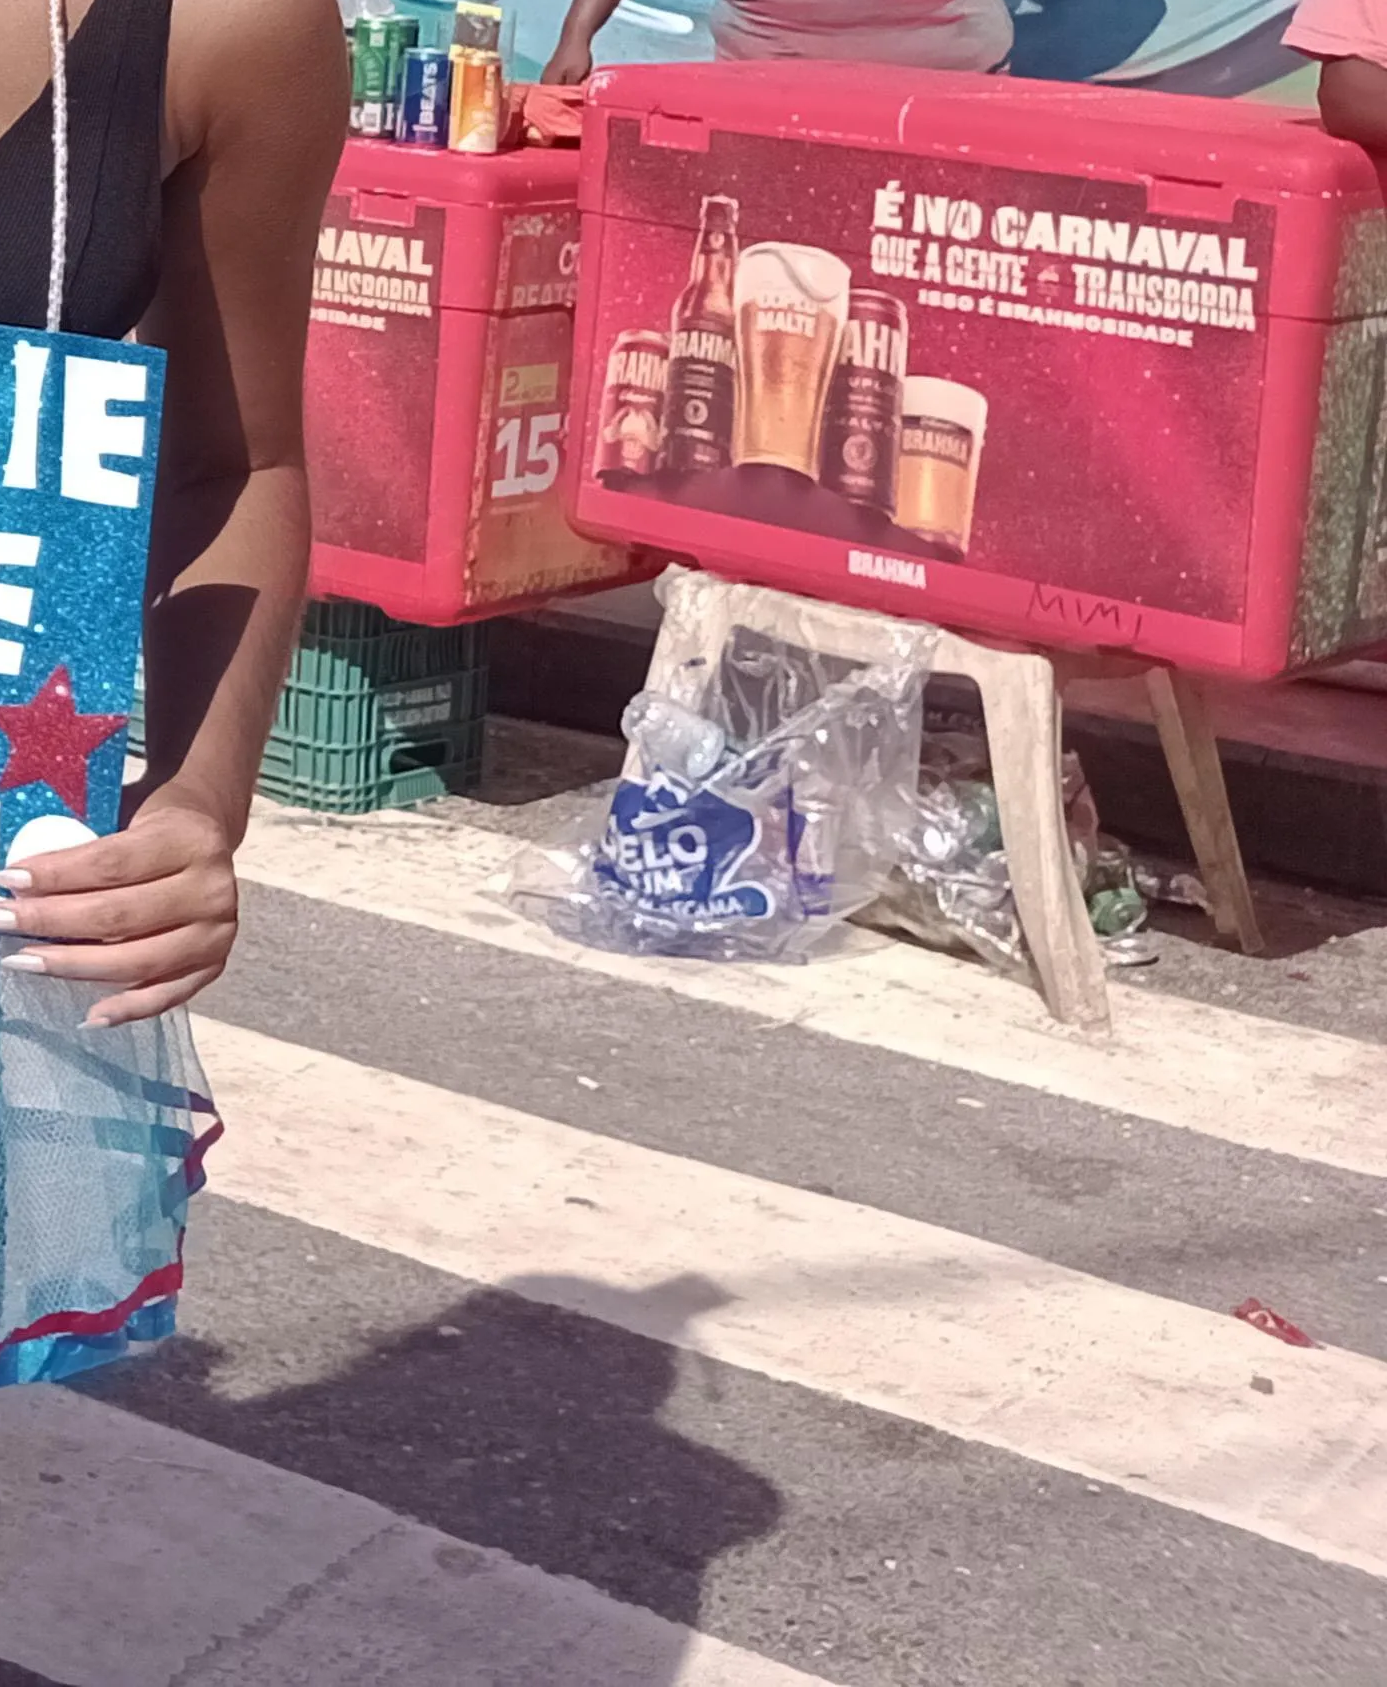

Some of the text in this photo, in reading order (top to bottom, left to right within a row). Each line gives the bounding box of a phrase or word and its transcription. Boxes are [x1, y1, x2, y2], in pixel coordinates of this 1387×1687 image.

[316, 227, 433, 277] NAVAL
[874, 180, 1258, 282] É NO CARNAVAL
[313, 267, 432, 318] ANSBORDA
[871, 233, 1256, 332] QUE A GENTE TRANSBORDA
[918, 288, 975, 312] ISSO
[997, 301, 1194, 348] BRAHMOSIDADE
[491, 413, 561, 499] 15
[901, 428, 969, 463] BRAHMA
[848, 549, 927, 590] BRAHMA
